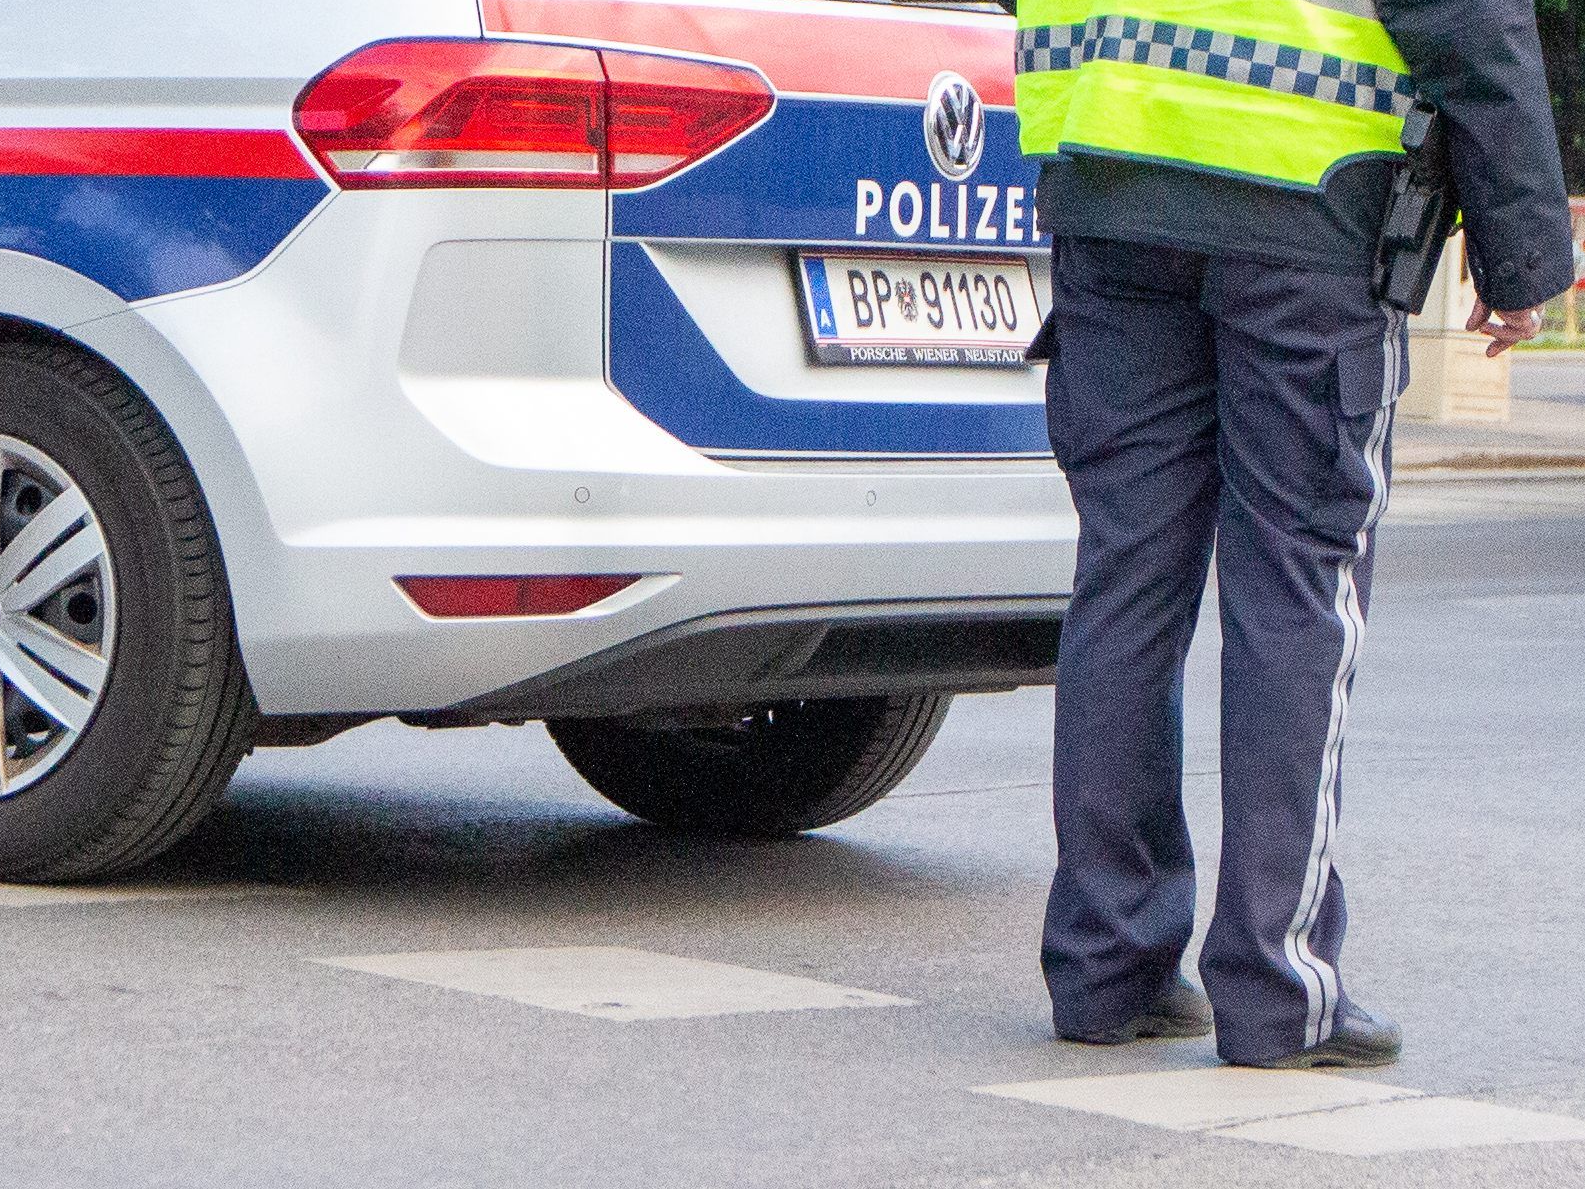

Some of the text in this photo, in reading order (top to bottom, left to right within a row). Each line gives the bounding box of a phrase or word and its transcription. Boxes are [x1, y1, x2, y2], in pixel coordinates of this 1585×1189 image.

[847, 269, 1018, 332] BP 91130
[850, 347, 1024, 363] PORSCHE WIENER NEUSTADT
